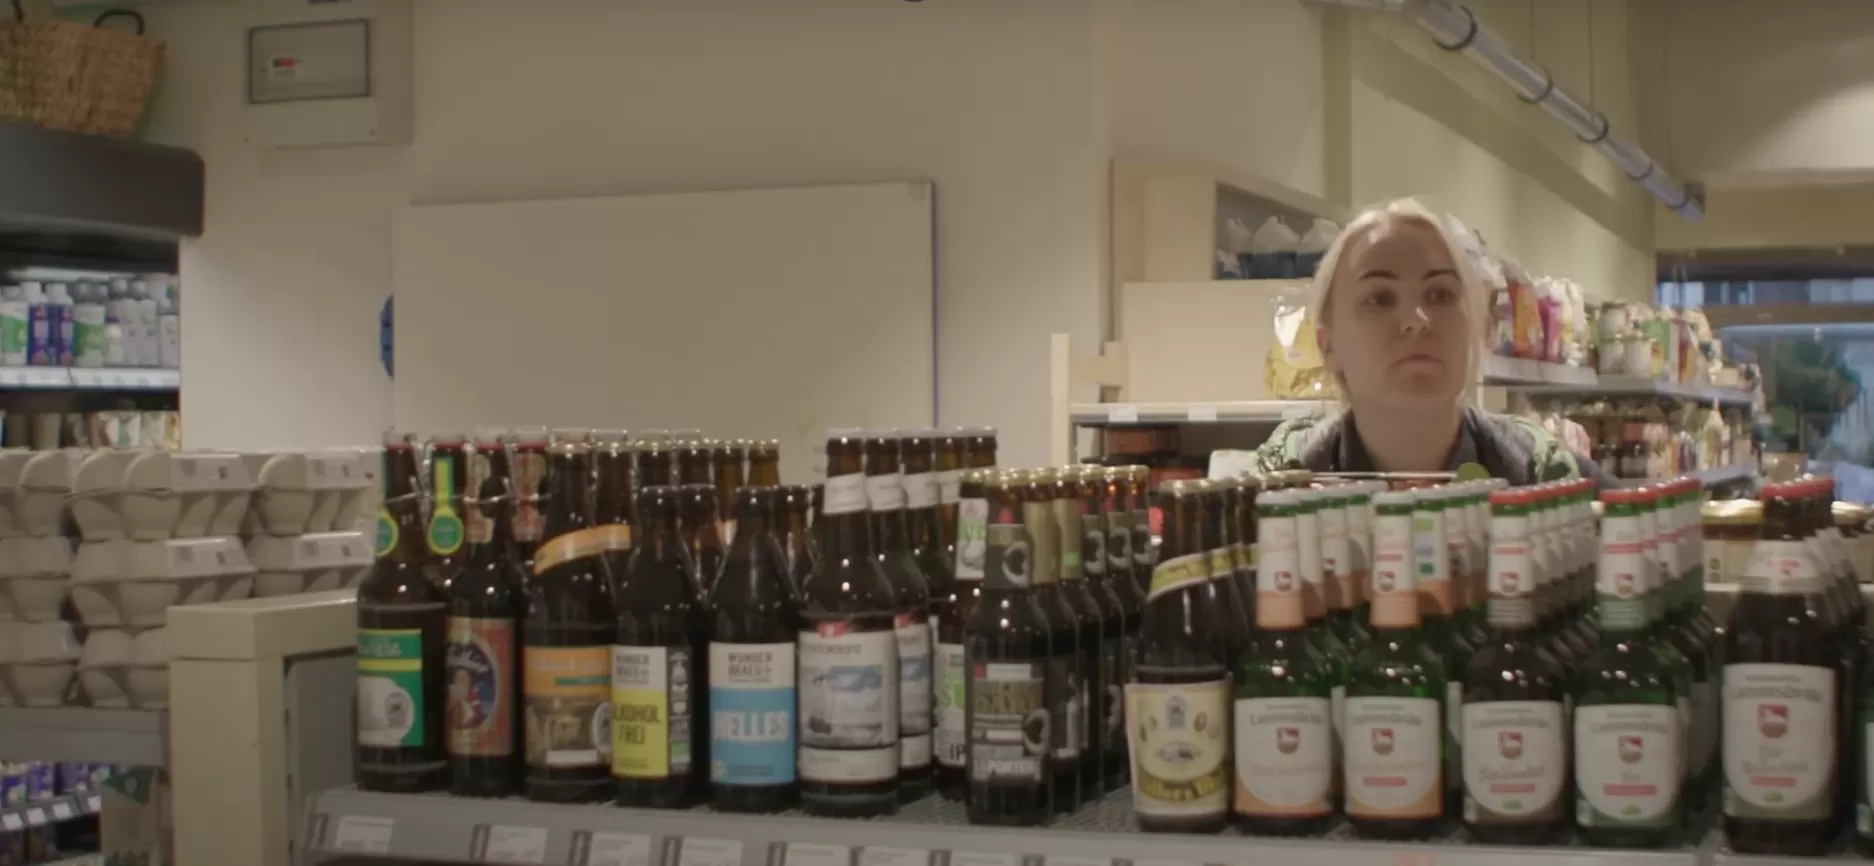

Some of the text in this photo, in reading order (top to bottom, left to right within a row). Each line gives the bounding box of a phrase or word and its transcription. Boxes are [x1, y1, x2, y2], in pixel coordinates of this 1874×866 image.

[613, 703, 661, 723] LKOHOL
[714, 710, 788, 742] HELLES
[950, 743, 966, 761] IP
